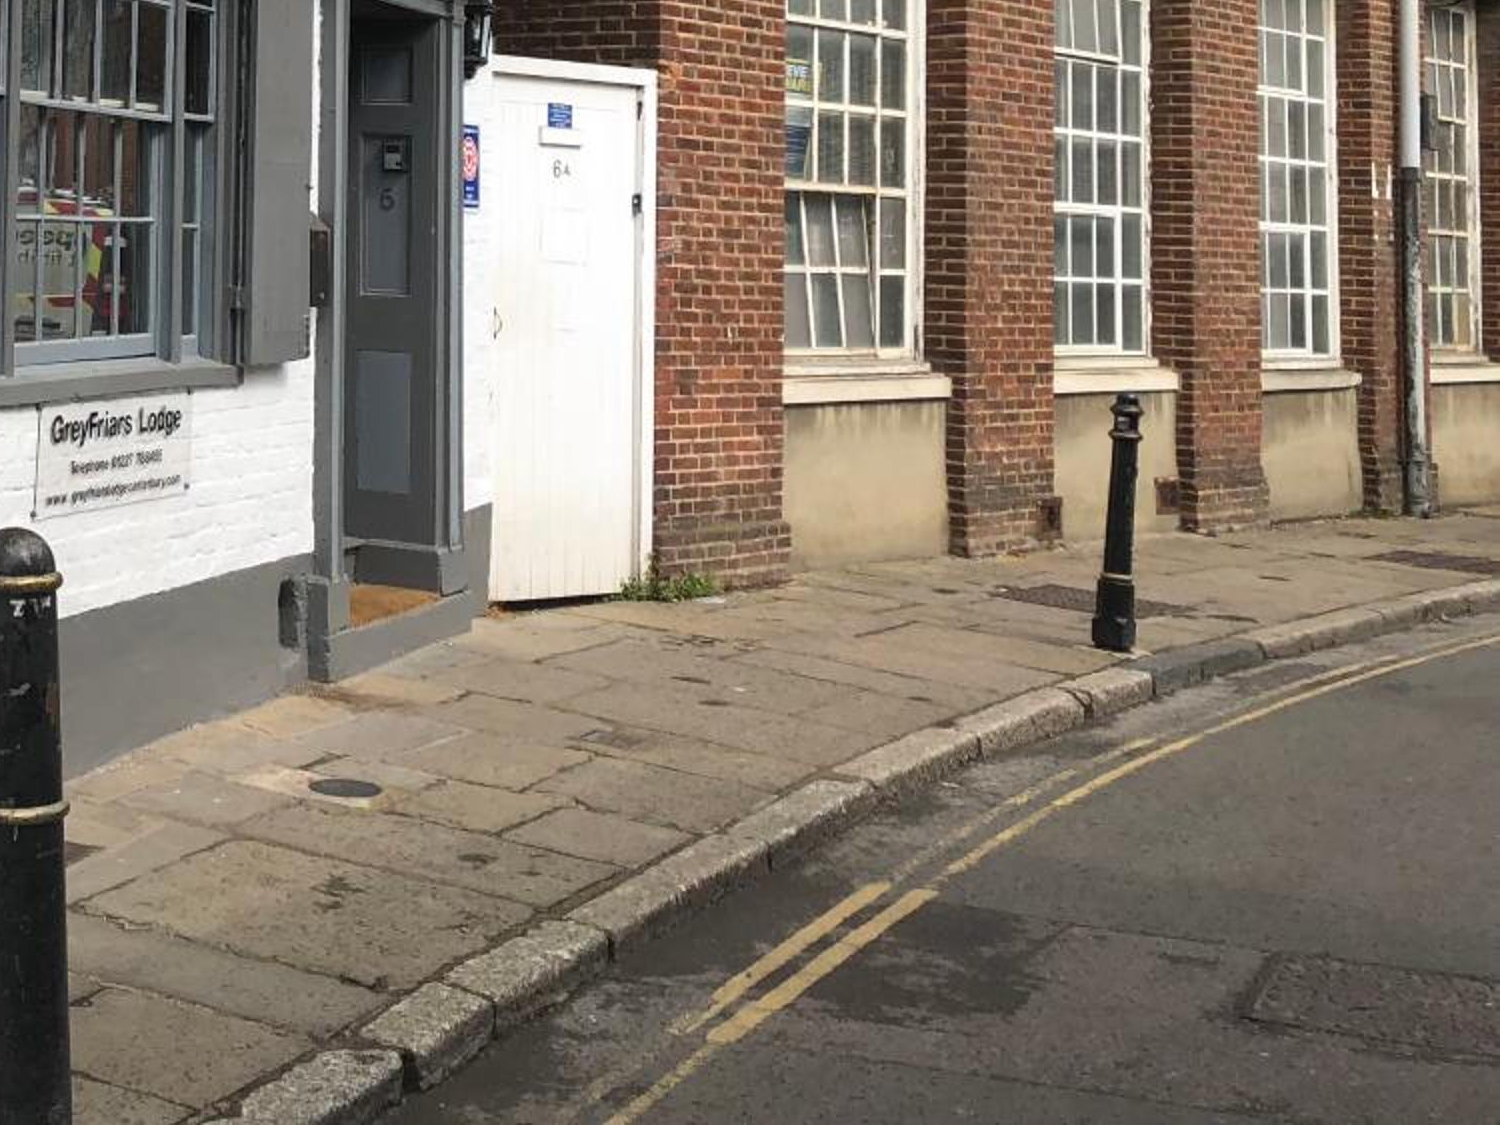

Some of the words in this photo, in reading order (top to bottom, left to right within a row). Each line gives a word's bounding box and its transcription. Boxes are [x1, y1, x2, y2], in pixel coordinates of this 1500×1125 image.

[552, 159, 571, 178] 6A
[51, 411, 133, 447] GreyFriars
[139, 405, 182, 436] Lodge
